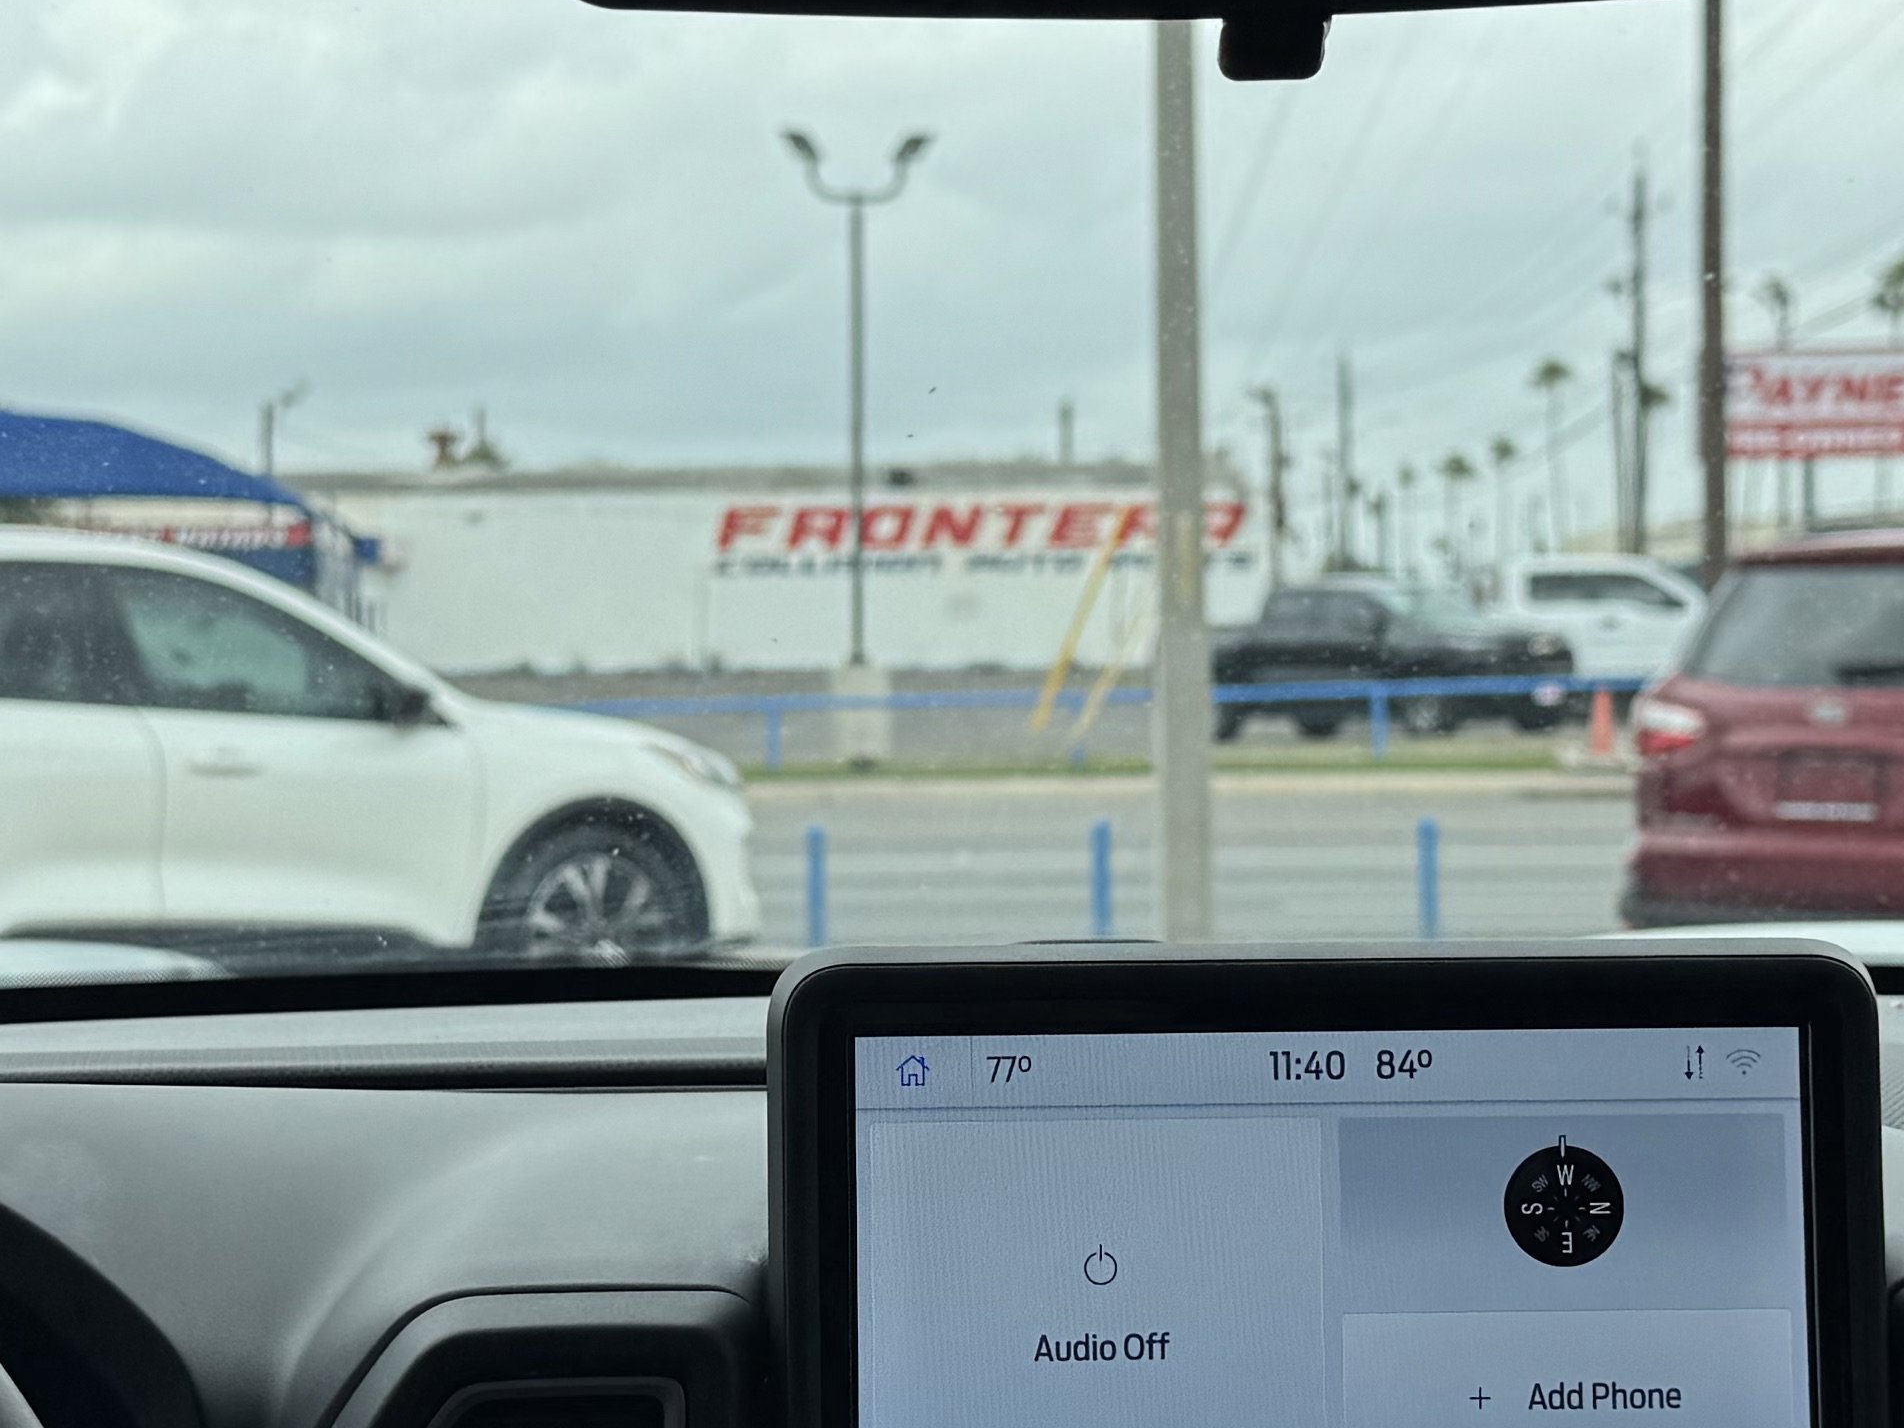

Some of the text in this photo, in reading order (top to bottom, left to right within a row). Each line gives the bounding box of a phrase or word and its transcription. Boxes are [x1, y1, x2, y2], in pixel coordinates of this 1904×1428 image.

[1269, 1049, 1346, 1083] 11:40
[1376, 1049, 1433, 1082] 84°
[1555, 1164, 1575, 1187] W
[1033, 1332, 1171, 1364] Audio Off
[1527, 1380, 1682, 1412] Add Phone
